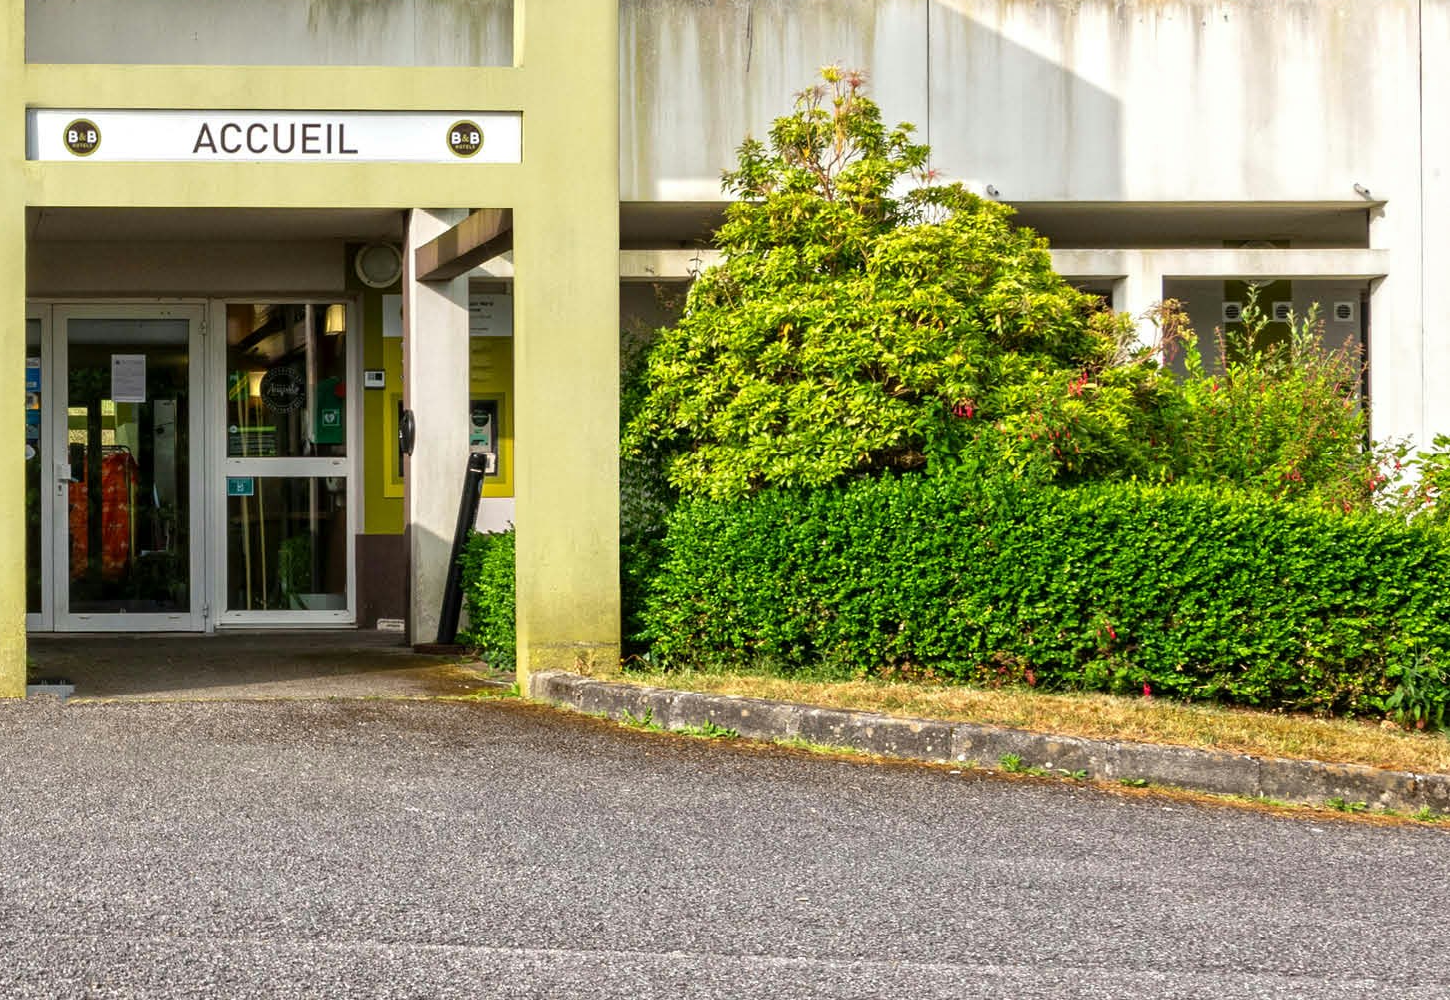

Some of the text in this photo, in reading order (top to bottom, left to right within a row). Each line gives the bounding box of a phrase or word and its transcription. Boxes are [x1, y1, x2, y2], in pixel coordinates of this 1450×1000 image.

[68, 130, 97, 143] B&B
[192, 122, 358, 154] ACCUEIL
[451, 131, 480, 144] B&B
